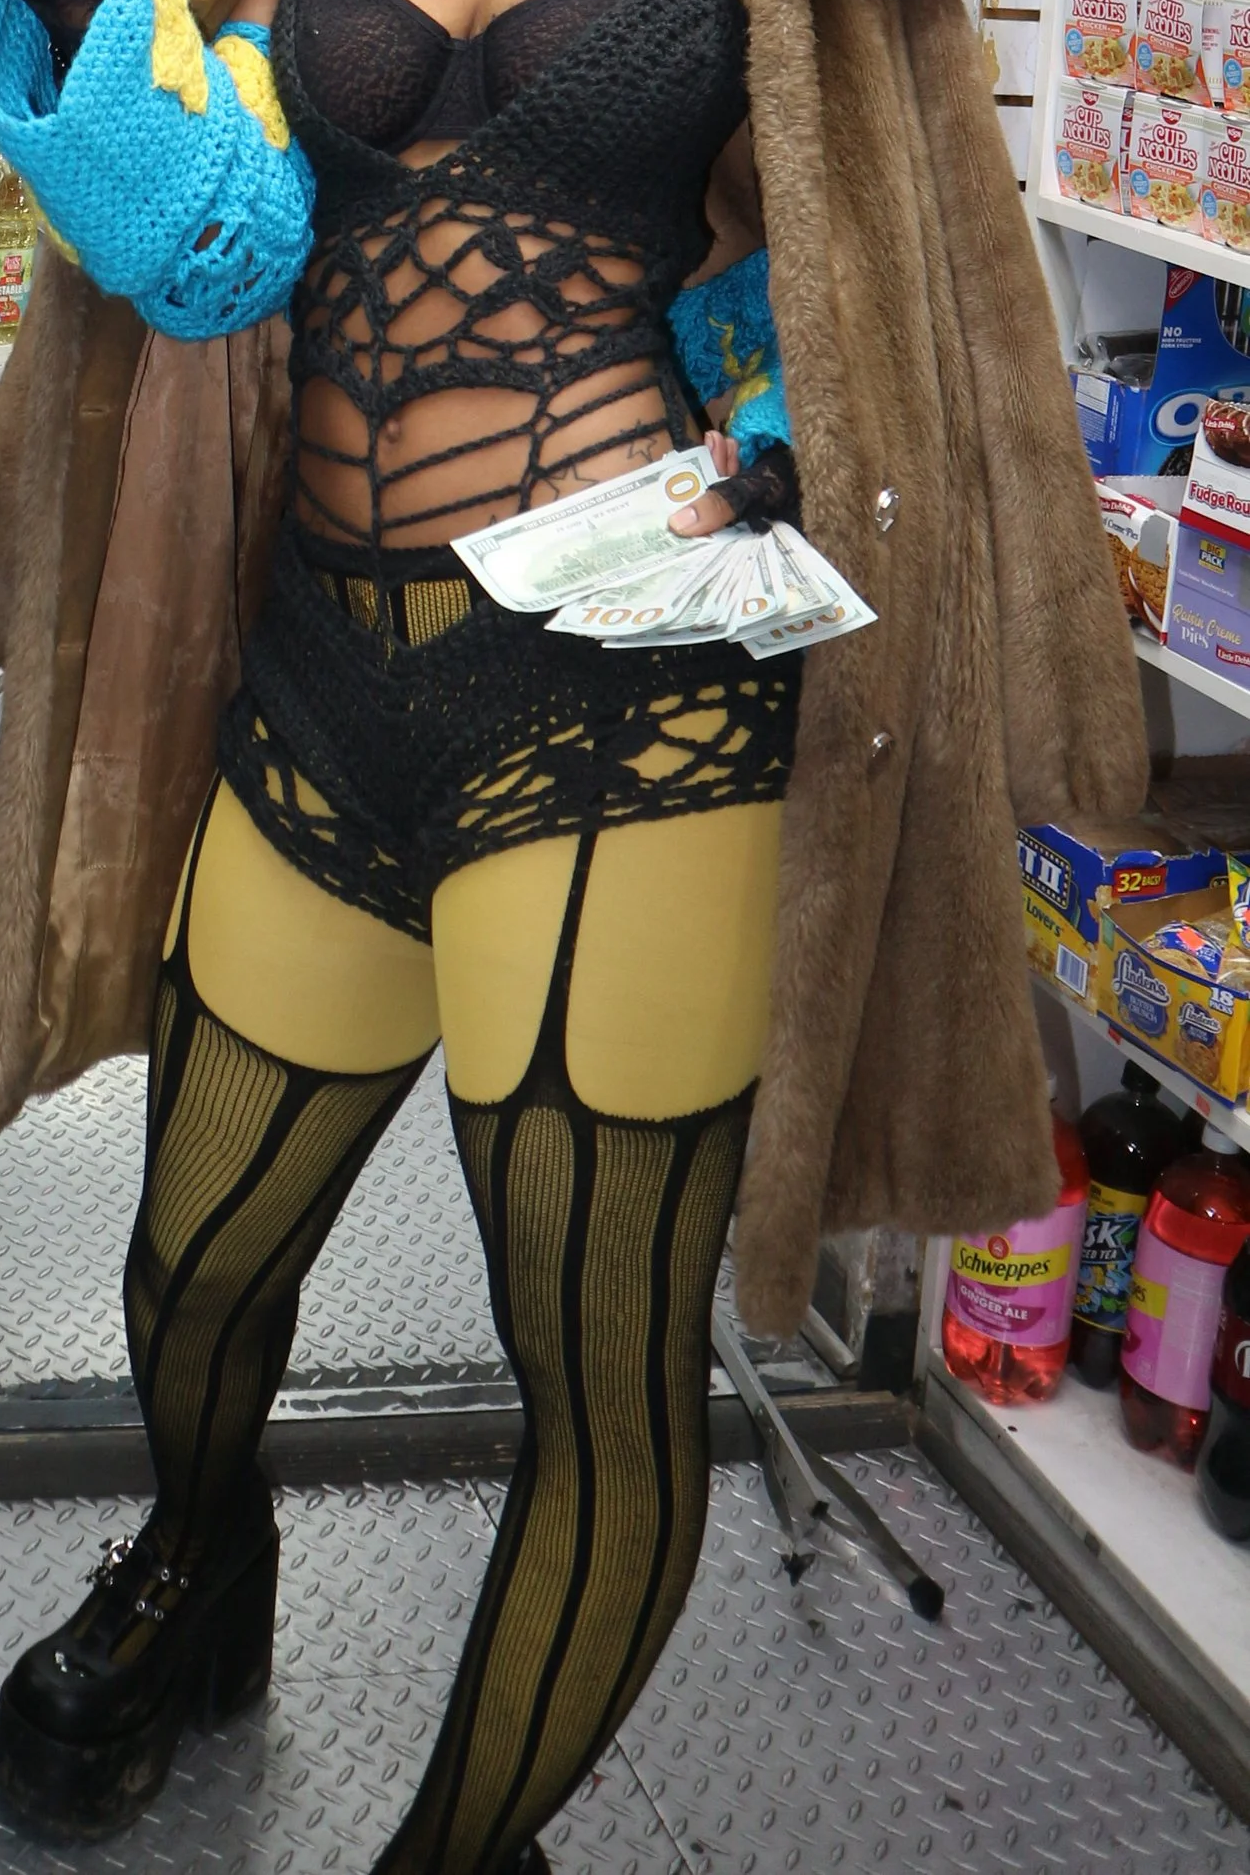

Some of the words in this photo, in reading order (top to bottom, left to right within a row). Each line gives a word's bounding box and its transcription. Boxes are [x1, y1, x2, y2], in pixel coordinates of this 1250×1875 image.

[1145, 10, 1192, 44] NOODLES
[1075, 106, 1103, 127] CUP
[1063, 119, 1111, 149] NOODLES
[1153, 125, 1187, 148] CUP
[1137, 137, 1198, 171] NOODLES
[1219, 142, 1246, 166] CUP
[1162, 326, 1183, 338] NO
[1189, 481, 1226, 507] Fudge
[1125, 526, 1139, 540] Pies
[468, 536, 499, 560] 100
[1206, 542, 1222, 557] BIG
[1201, 552, 1224, 568] PACK
[580, 605, 665, 627] 100
[1172, 603, 1204, 630] Raisin
[1205, 619, 1242, 645] Creme
[1181, 626, 1210, 649] Pies
[1217, 648, 1234, 662] Little
[1117, 872, 1142, 893] 32
[1113, 952, 1171, 1005] Linden's
[1129, 994, 1155, 1013] BUTTER
[1209, 1000, 1234, 1015] PACKS
[1210, 987, 1235, 1006] 18
[1178, 1003, 1222, 1033] Linden's
[956, 1247, 1051, 1282] Schweppes
[1099, 1249, 1117, 1260] TEA
[960, 1285, 1003, 1317] GINGER
[1006, 1306, 1029, 1321] ALE
